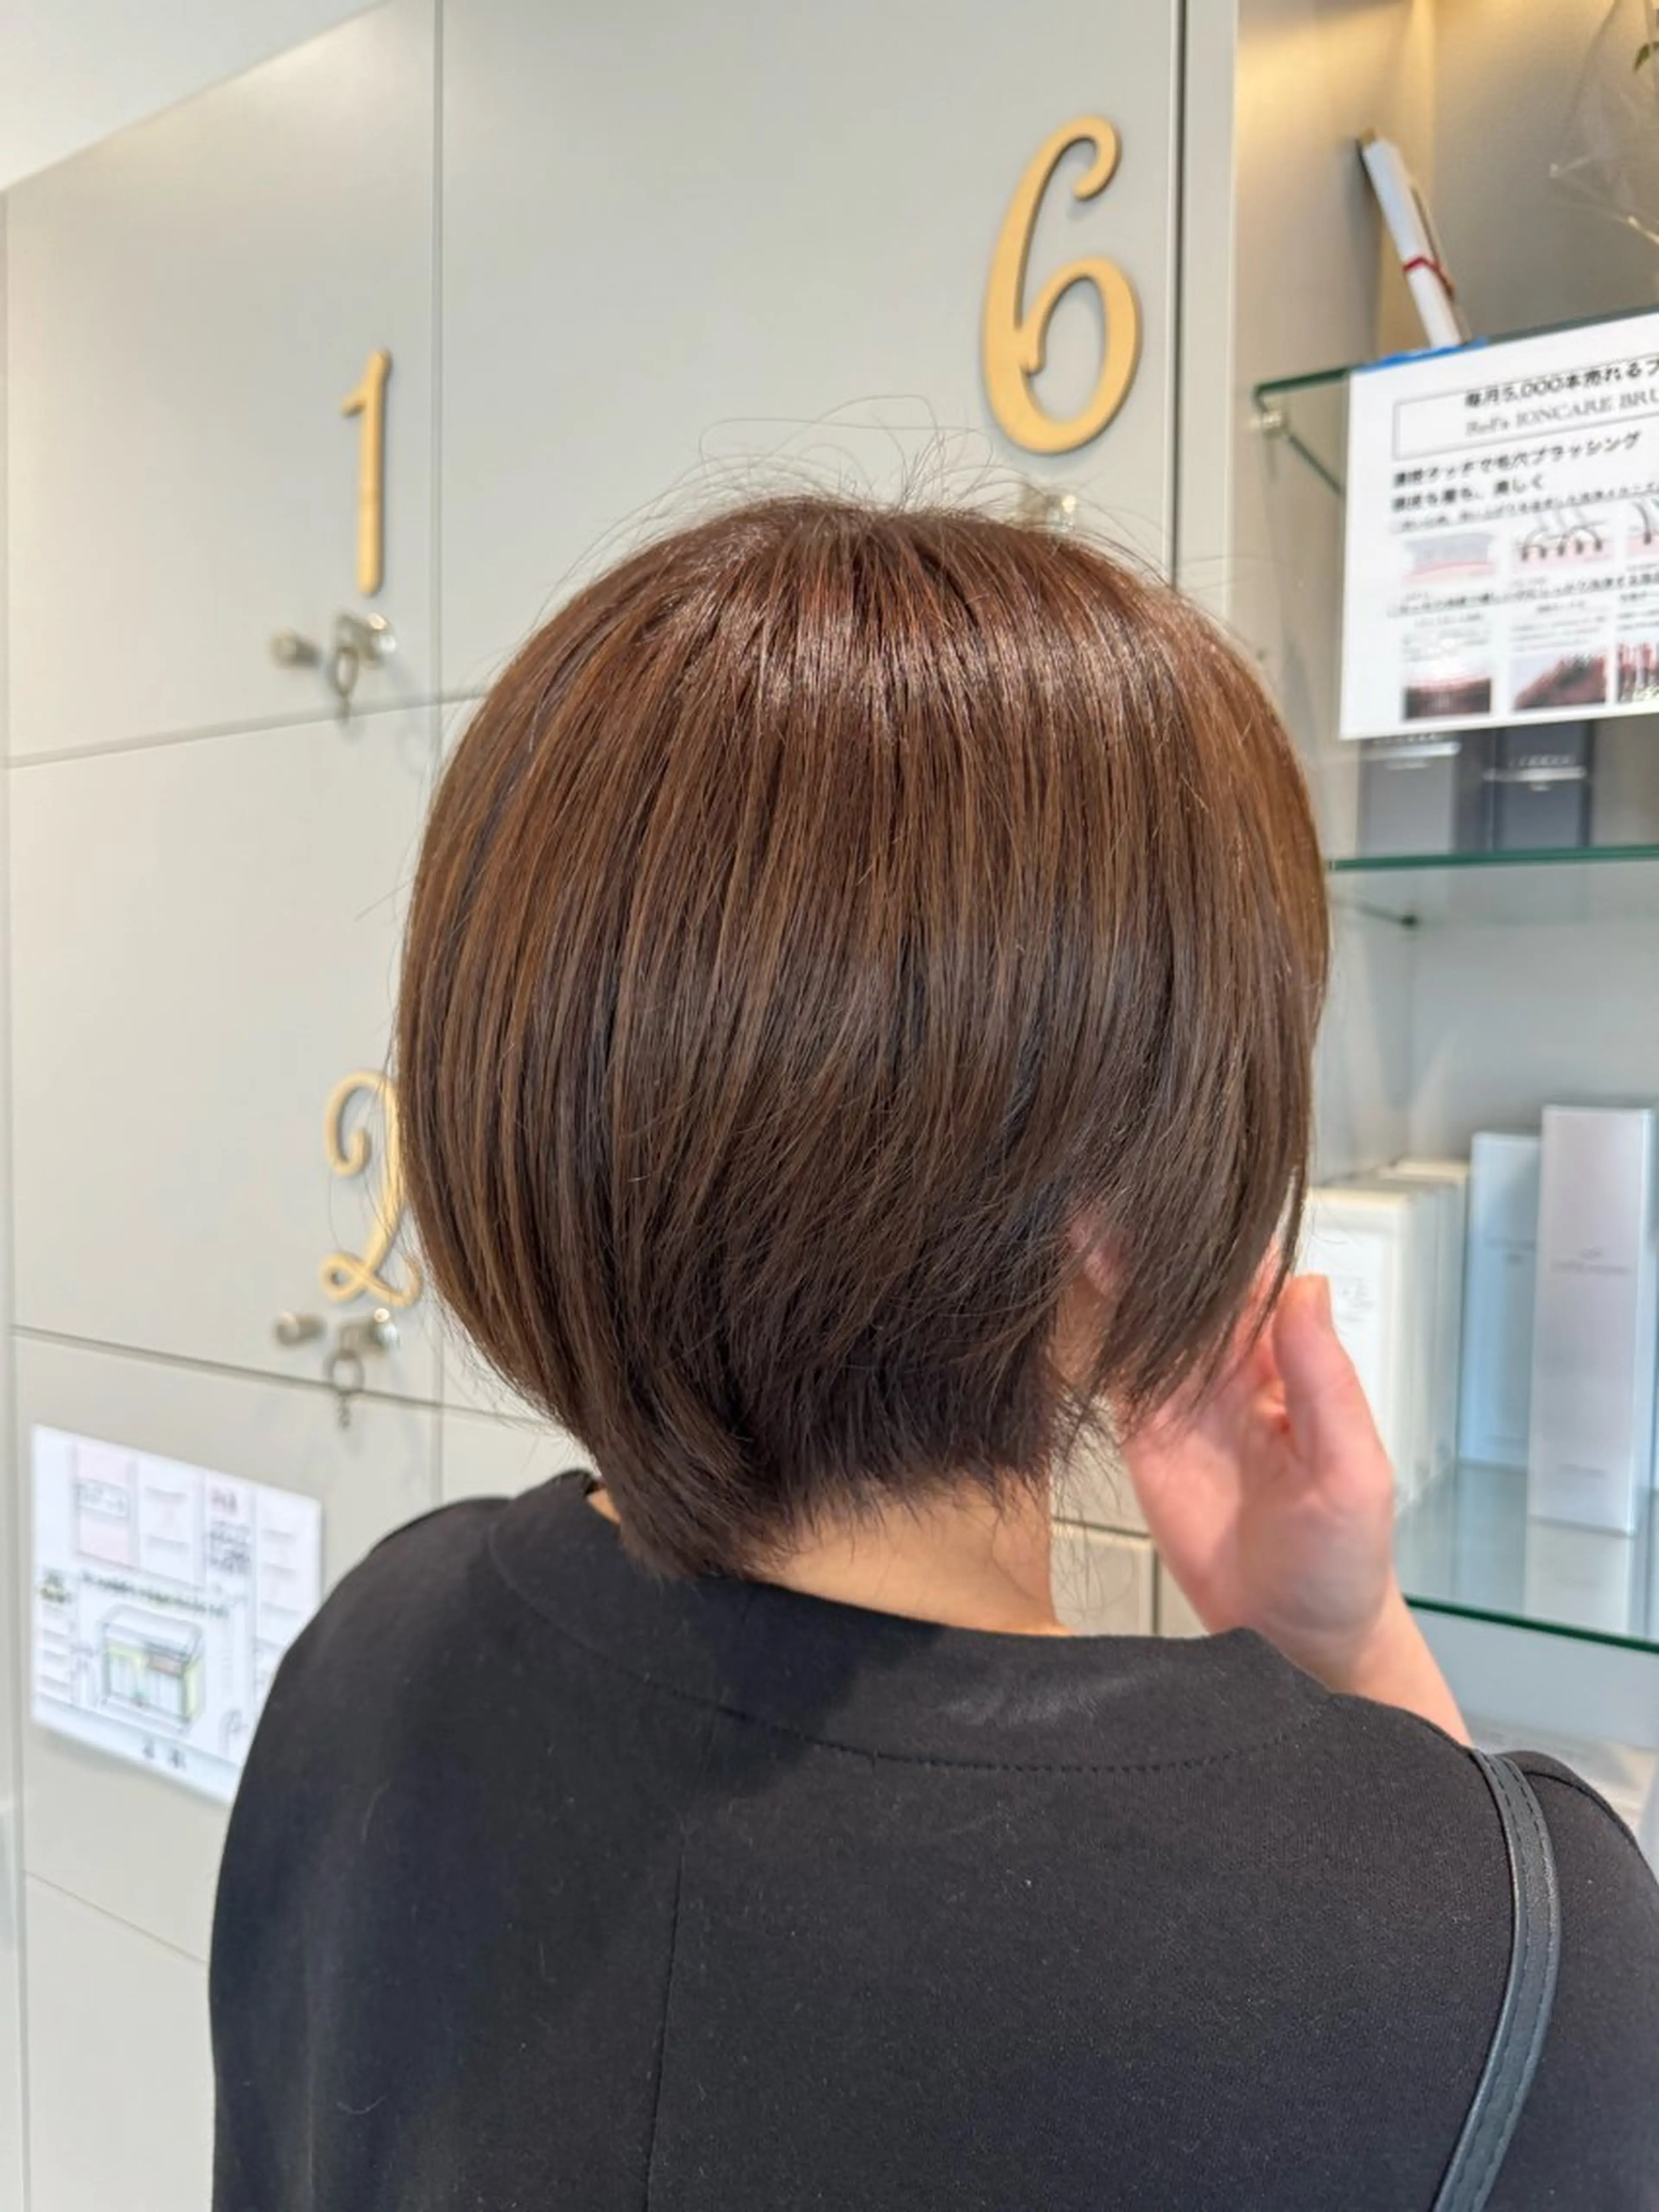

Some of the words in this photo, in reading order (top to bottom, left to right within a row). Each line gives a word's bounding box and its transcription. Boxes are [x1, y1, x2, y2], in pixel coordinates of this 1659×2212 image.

[980, 115, 1143, 455] 6
[343, 347, 391, 595] 1
[322, 1069, 422, 1308] 2
